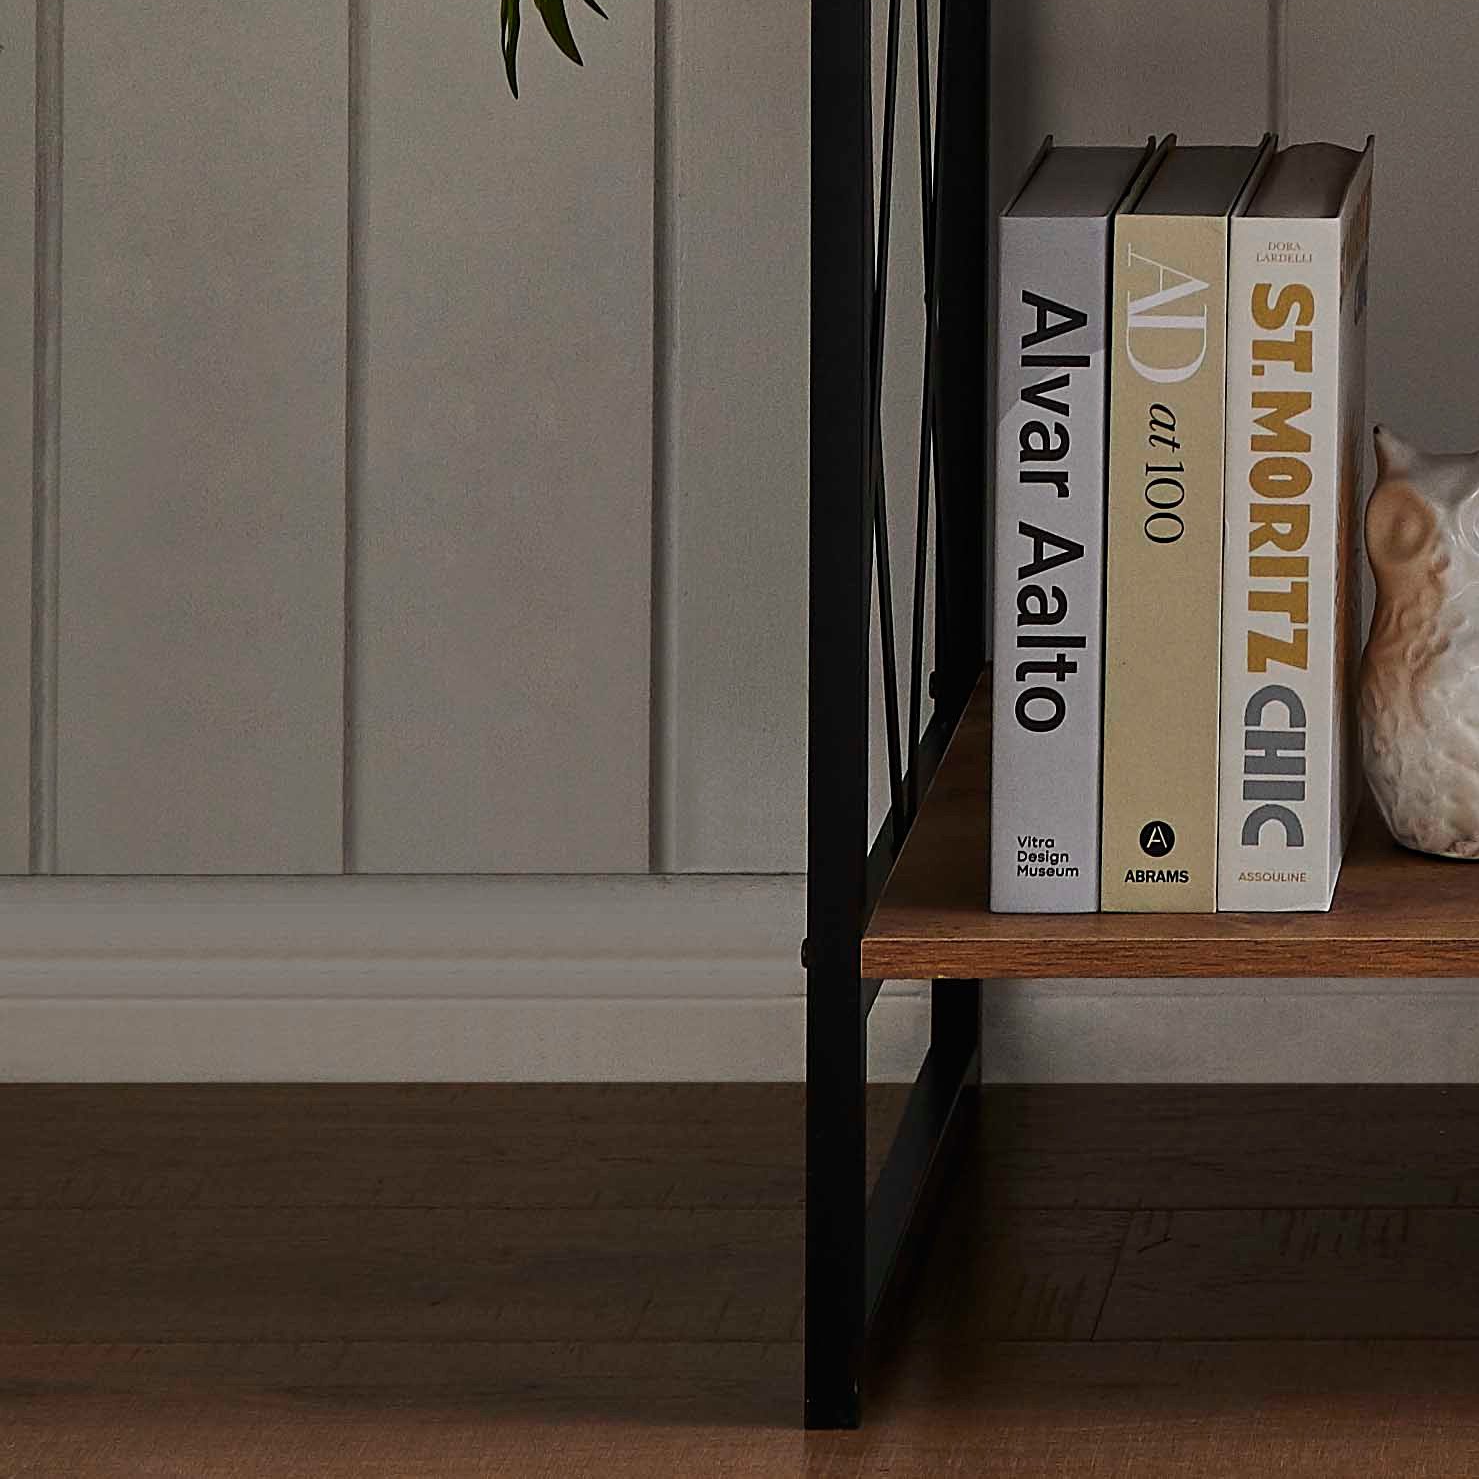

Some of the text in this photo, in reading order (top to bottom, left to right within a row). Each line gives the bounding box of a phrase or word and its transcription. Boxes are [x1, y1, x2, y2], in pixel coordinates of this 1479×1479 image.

[1126, 242, 1210, 544] AD at 100
[1014, 289, 1091, 733] Alvar Aalto
[1241, 684, 1307, 848] CHIC
[1017, 835, 1055, 849] Vitra
[1017, 849, 1069, 865] Design
[1017, 864, 1079, 878] Museum
[1124, 869, 1189, 884] ABRAMS
[1237, 871, 1307, 883] ASSOULINE
